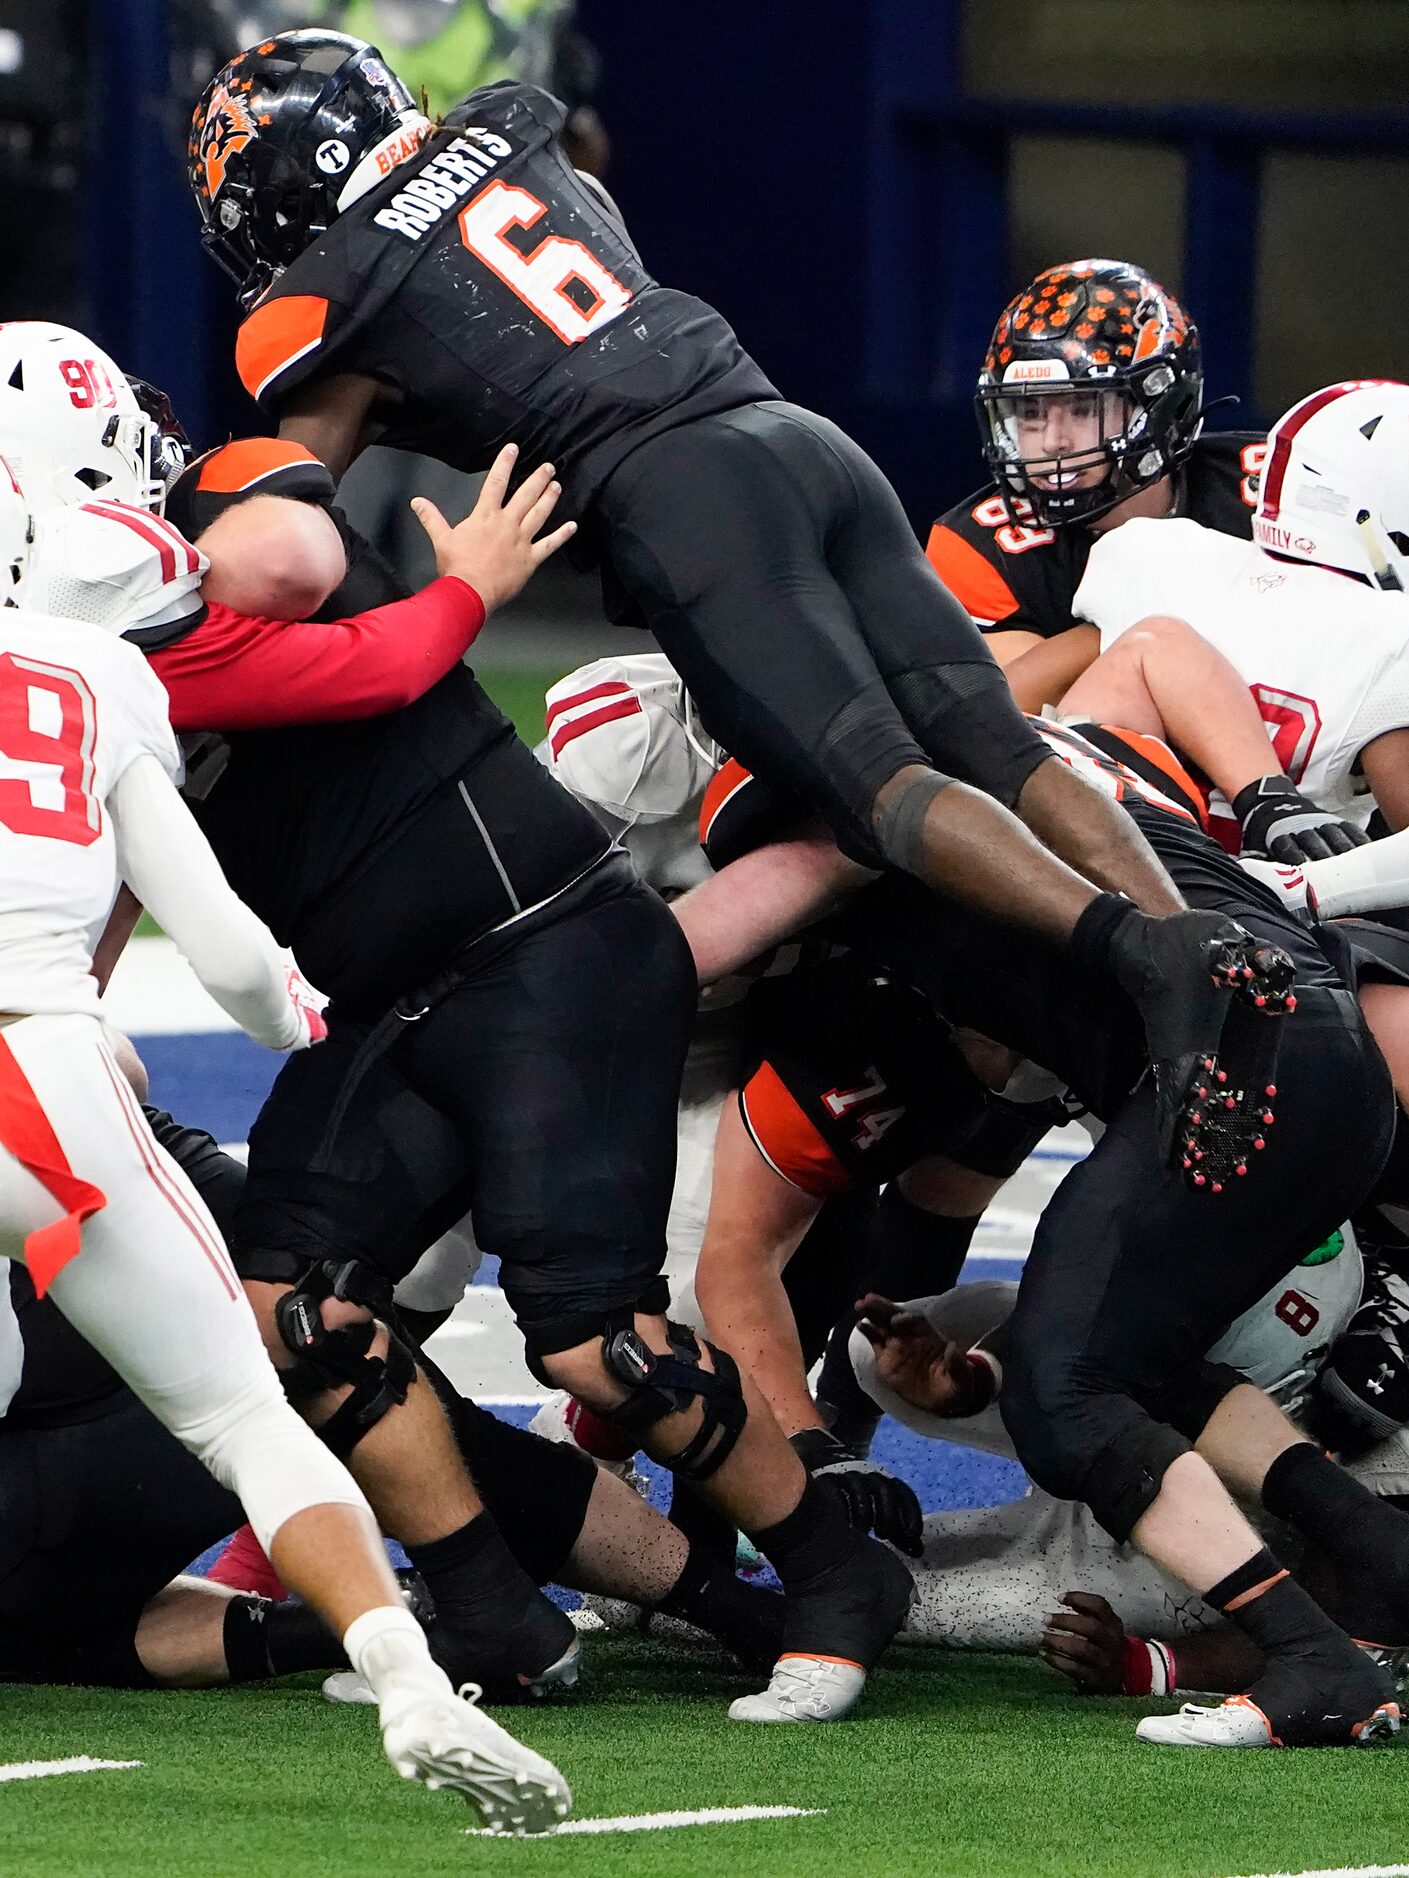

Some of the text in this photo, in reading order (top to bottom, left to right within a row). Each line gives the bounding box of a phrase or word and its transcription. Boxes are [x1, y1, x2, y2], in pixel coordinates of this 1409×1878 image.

[373, 127, 513, 241] ROBERTS
[458, 178, 634, 347] 6
[58, 359, 117, 408] 90
[1013, 366, 1052, 379] ALEDO
[1275, 1289, 1320, 1338] 8
